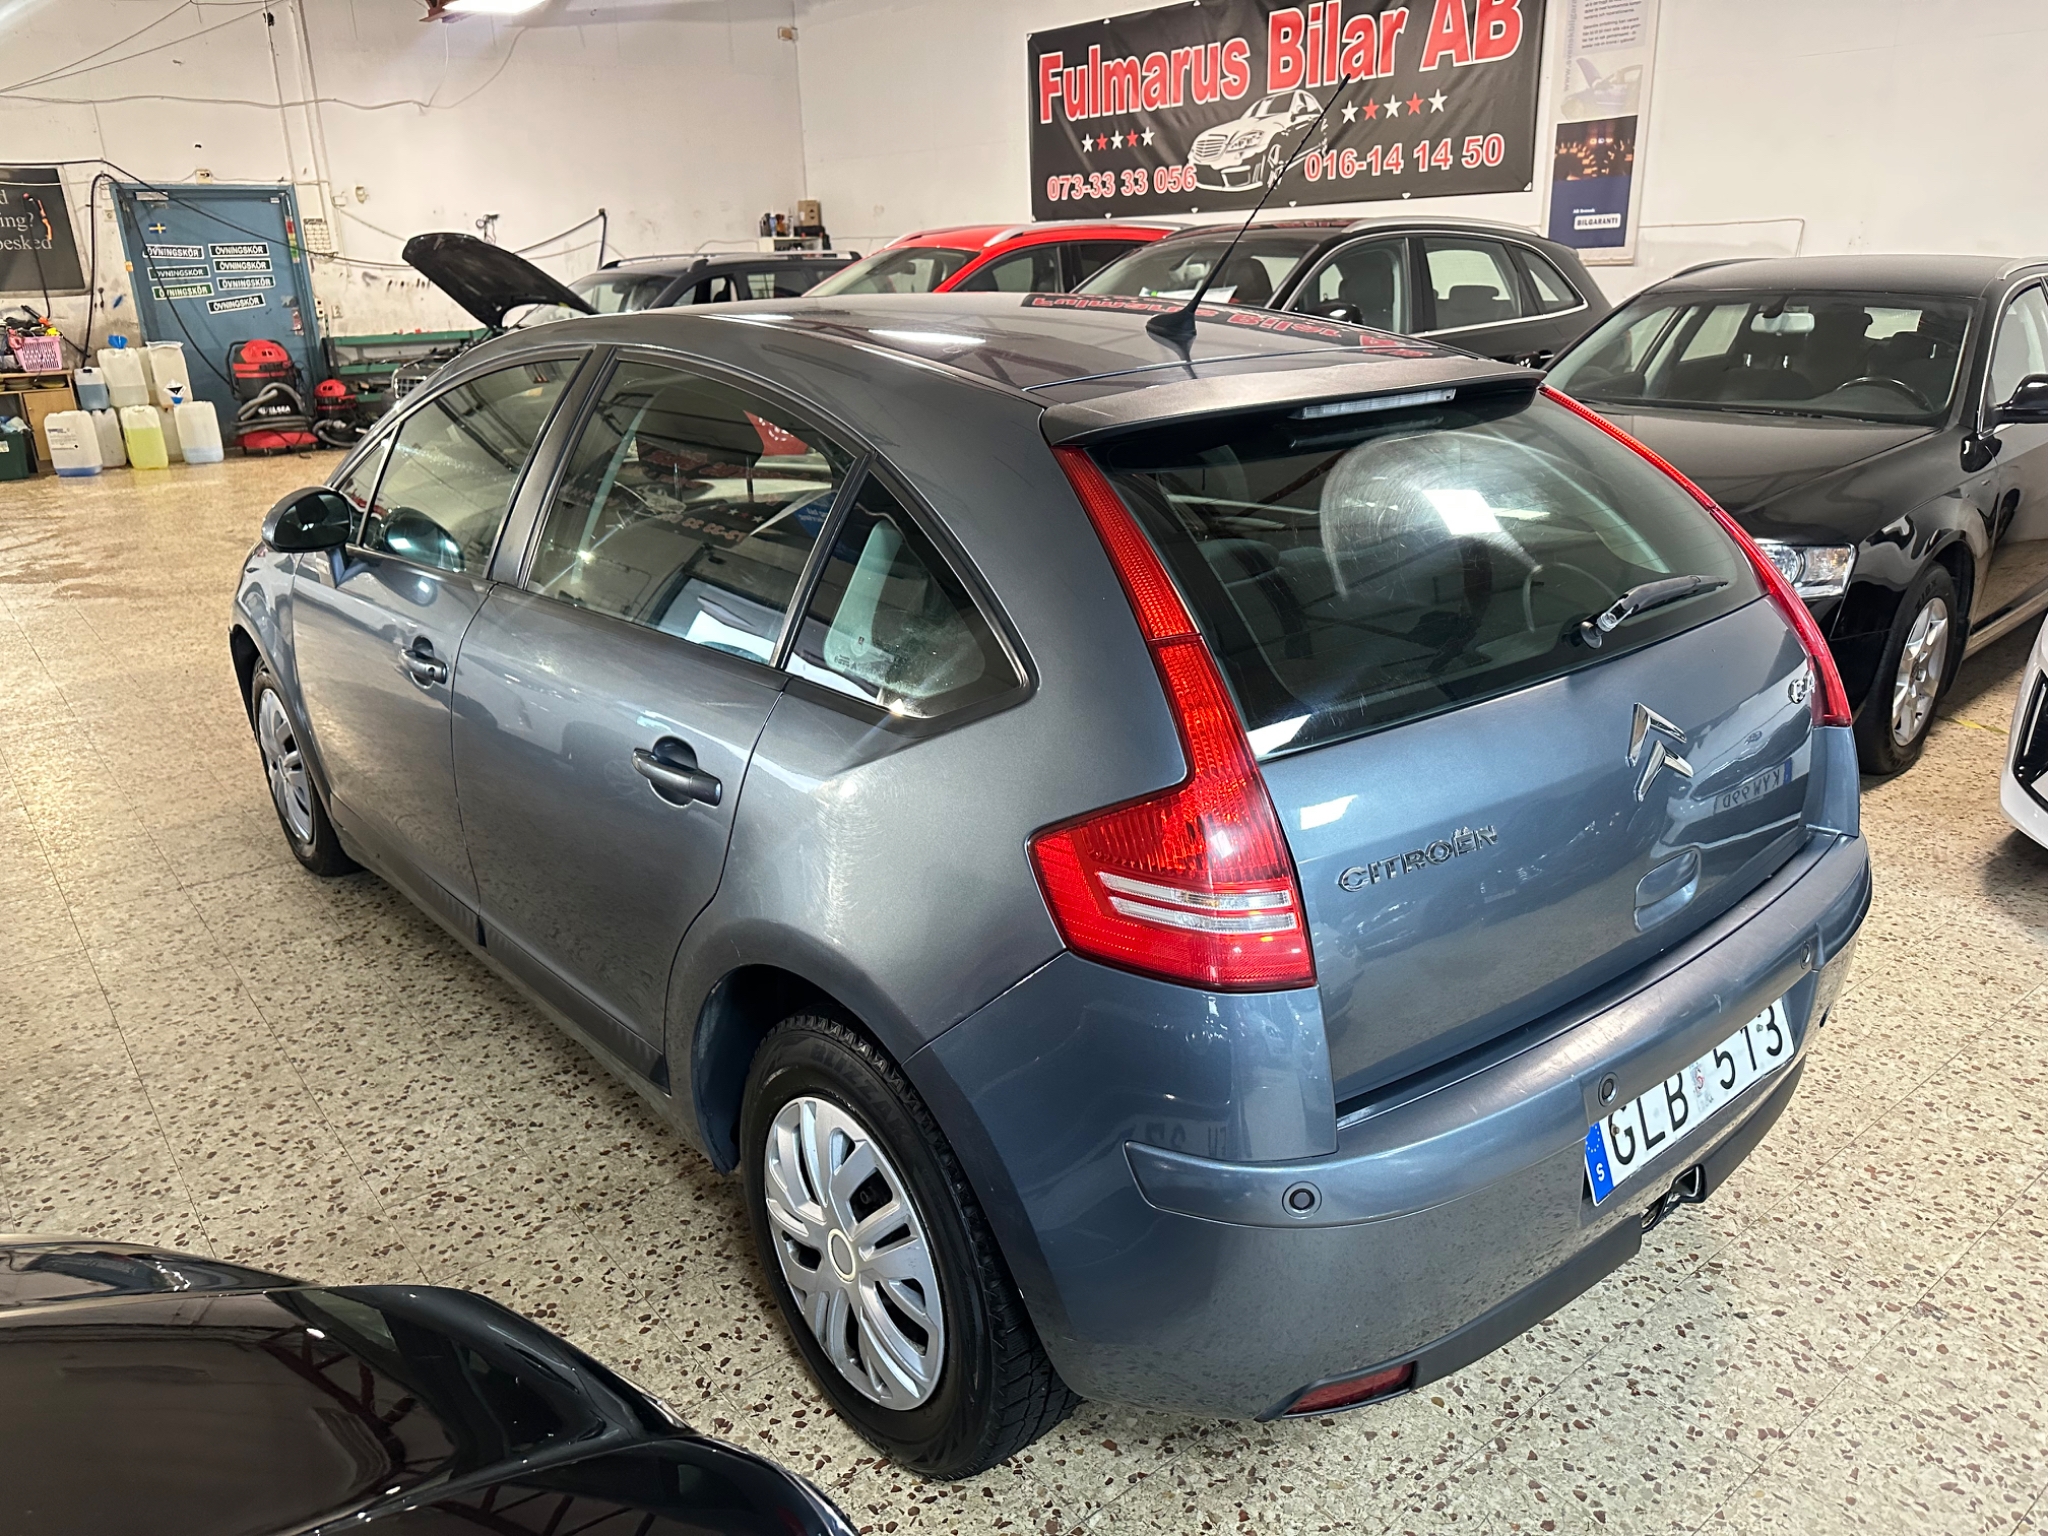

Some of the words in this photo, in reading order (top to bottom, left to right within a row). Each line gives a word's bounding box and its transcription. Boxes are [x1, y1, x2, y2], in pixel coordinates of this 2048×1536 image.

[1039, 37, 1251, 124] Fulmarus
[1267, 0, 1409, 93] Bilar
[1419, 0, 1524, 72] AB
[1304, 143, 1404, 182] 016-14
[1413, 138, 1452, 172] 14
[1461, 133, 1505, 168] 50
[1047, 171, 1115, 201] 073-33
[1120, 168, 1148, 196] 33
[1154, 165, 1197, 194] 056
[1577, 217, 1618, 227] BILGARANTI
[214, 245, 264, 255] ÖVNINGSKÖR
[219, 260, 267, 270] ÖVNINGSKÖR
[221, 277, 272, 288] ÖVNINGSKÖR
[213, 297, 260, 311] ÖVNINGSKÖR
[1337, 825, 1498, 892] CITROËN
[1608, 1072, 1689, 1166] GLB
[1596, 1162, 1605, 1182] S
